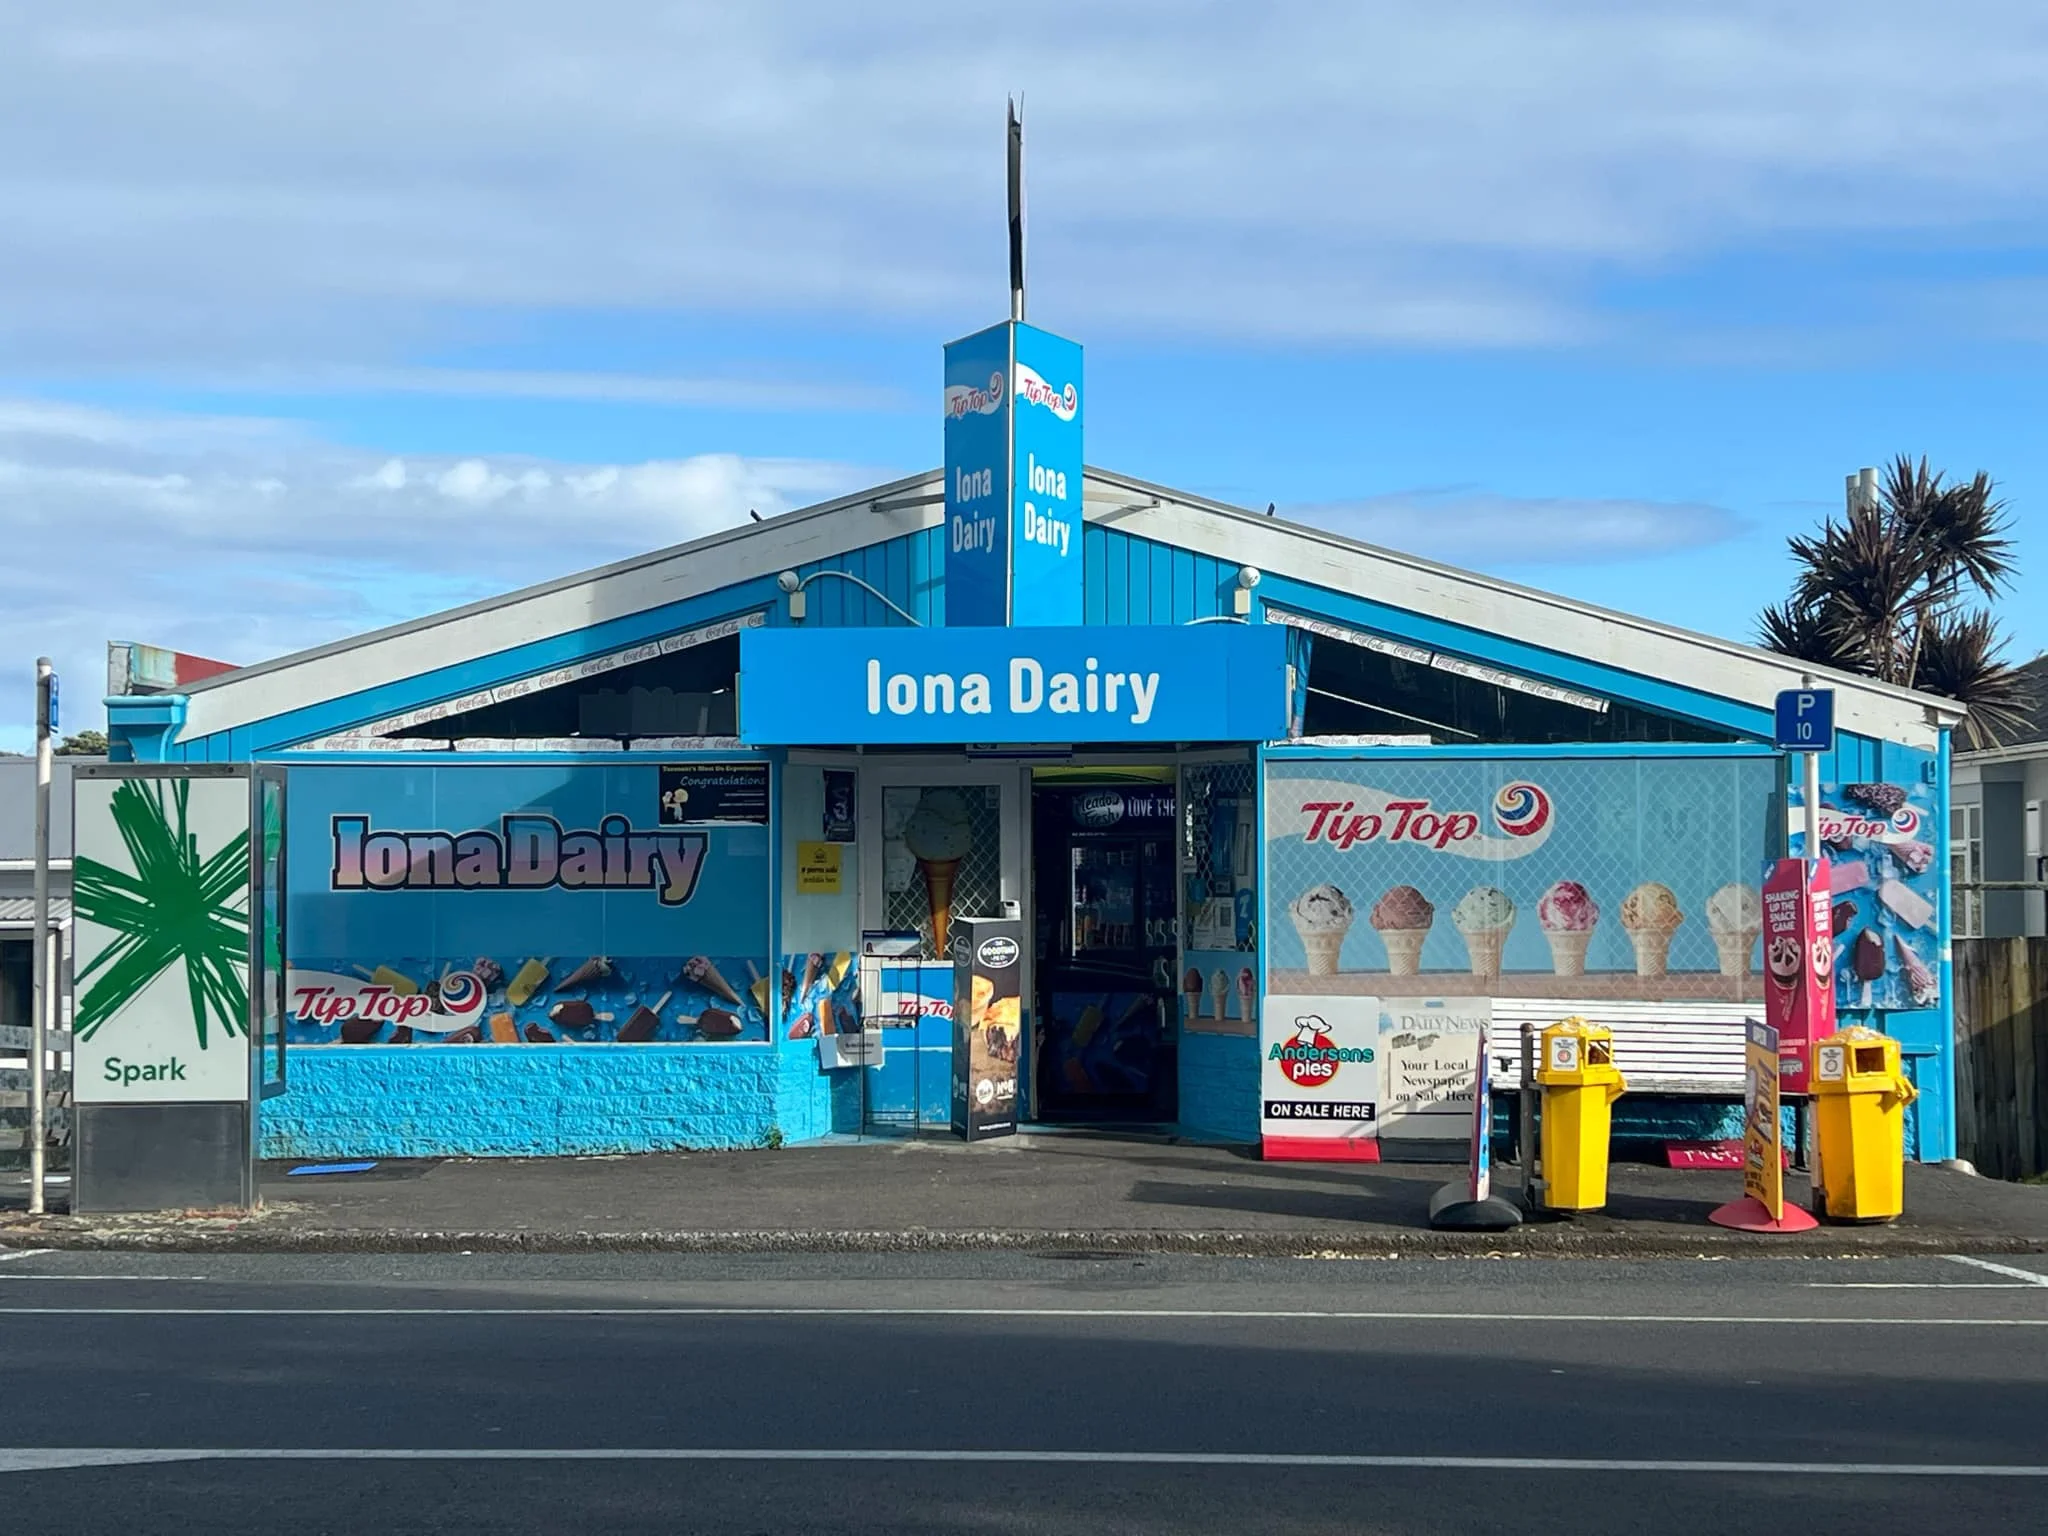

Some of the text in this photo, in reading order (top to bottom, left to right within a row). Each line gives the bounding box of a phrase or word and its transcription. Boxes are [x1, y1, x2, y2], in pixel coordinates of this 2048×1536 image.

[952, 390, 986, 415] Tip Top
[1024, 378, 1061, 408] Tip Top
[956, 466, 992, 503] Iona
[1028, 452, 1066, 500] Iona
[952, 510, 996, 553] Dairy
[1024, 502, 1070, 557] Dairy
[866, 657, 1160, 724] Iona Dairy
[1797, 694, 1816, 716] P
[1796, 722, 1812, 740] 10
[680, 776, 766, 788] Congratulations
[1128, 798, 1152, 816] LOVE
[1301, 802, 1382, 849] Tip
[1385, 802, 1478, 849] Top
[1819, 816, 1886, 838] ip Top
[332, 814, 708, 905] Iona Dairy
[1765, 890, 1800, 904] SHAKING
[1769, 900, 1796, 912] UP THE
[1770, 911, 1796, 922] SNACK
[1772, 920, 1796, 932] GAME
[294, 986, 432, 1024] Tip Top
[898, 1001, 928, 1017] Tip
[1268, 1043, 1374, 1063] Andersons
[104, 1056, 186, 1087] Spark
[1293, 1060, 1332, 1080] pies
[1401, 1060, 1468, 1070] Your Local
[1403, 1076, 1468, 1089] Newspaper
[1396, 1090, 1474, 1101] on Sale Here
[1271, 1104, 1370, 1118] ON SALE HERE
